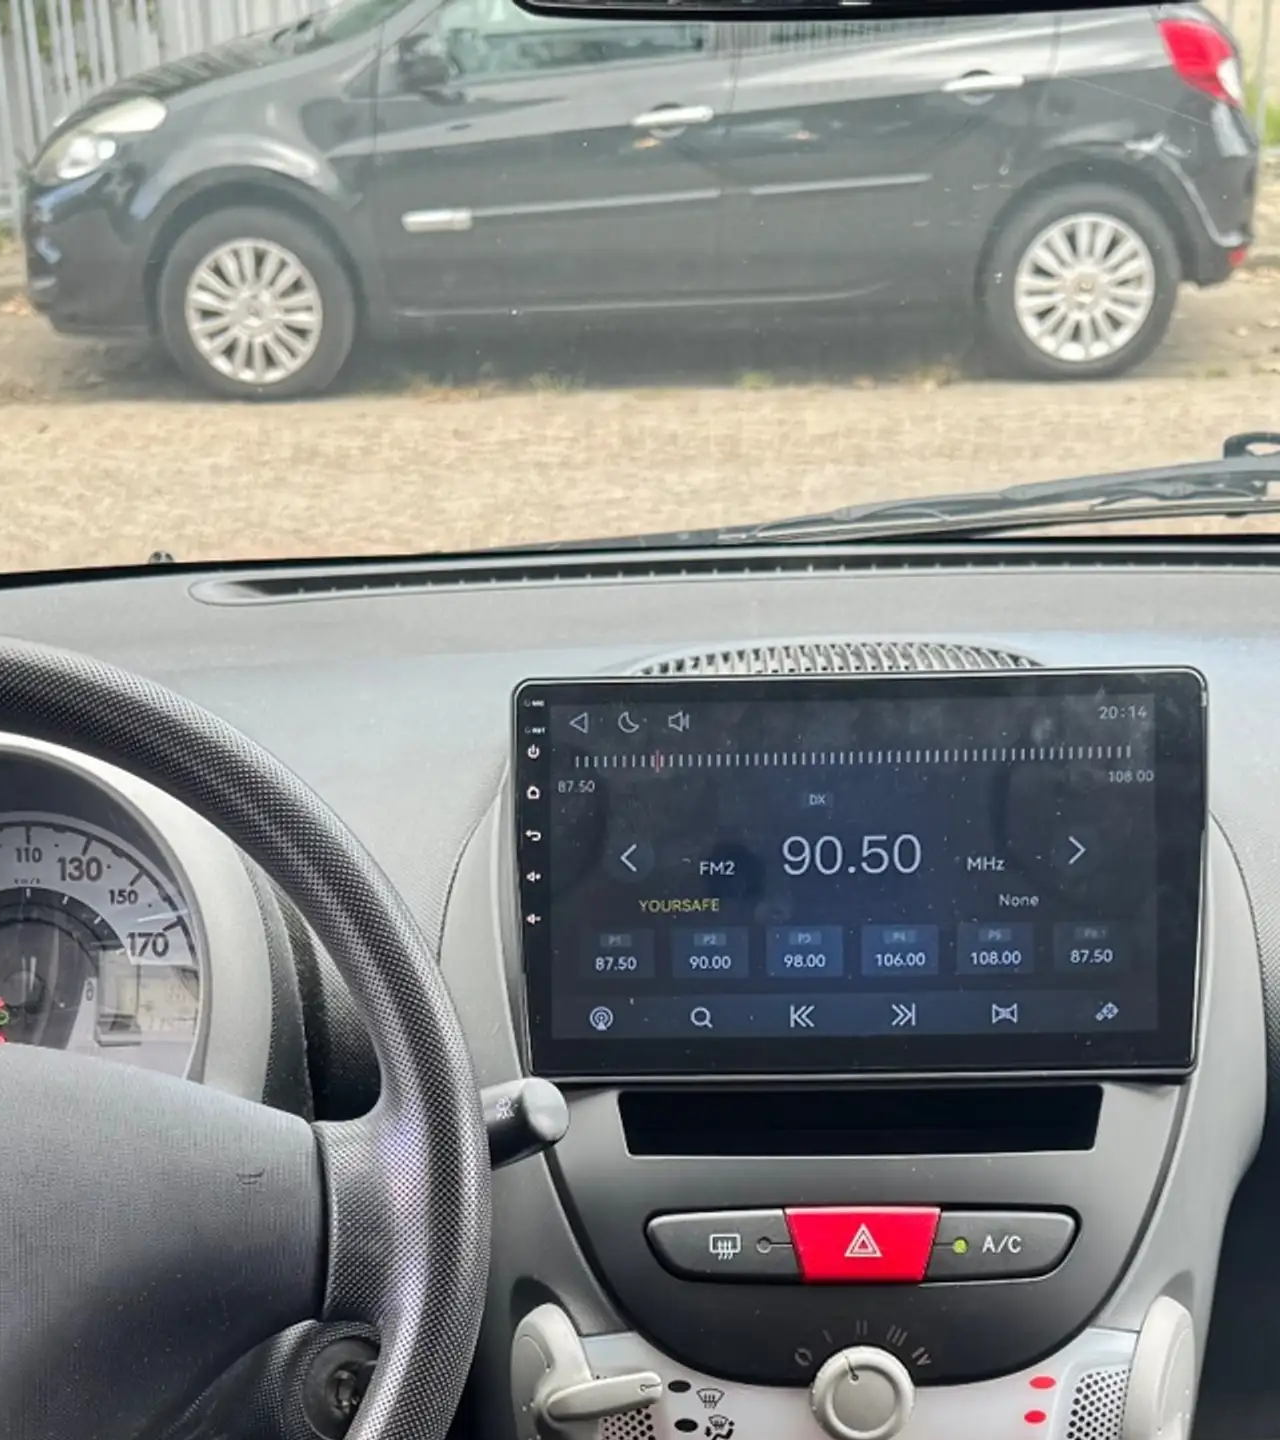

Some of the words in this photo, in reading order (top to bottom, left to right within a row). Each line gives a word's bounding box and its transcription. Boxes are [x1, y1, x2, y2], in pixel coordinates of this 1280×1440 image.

[1098, 705, 1148, 720] 20:14
[558, 780, 596, 793] 87.50
[15, 847, 43, 864] 110
[782, 834, 922, 875] 90.50
[966, 856, 1006, 871] MHz
[56, 856, 103, 881] 130
[699, 861, 736, 876] FM2
[109, 889, 139, 905] 150
[998, 893, 1040, 907] None
[639, 898, 720, 913] YOURSAFE
[127, 932, 169, 958] 170
[595, 956, 637, 971] 87.50
[689, 955, 732, 970] 90.00
[783, 954, 826, 968] 98.00
[875, 952, 926, 967] 106.00
[970, 950, 1022, 966] 108.00
[1070, 948, 1113, 964] 87.50
[981, 1234, 1022, 1253] A/C
